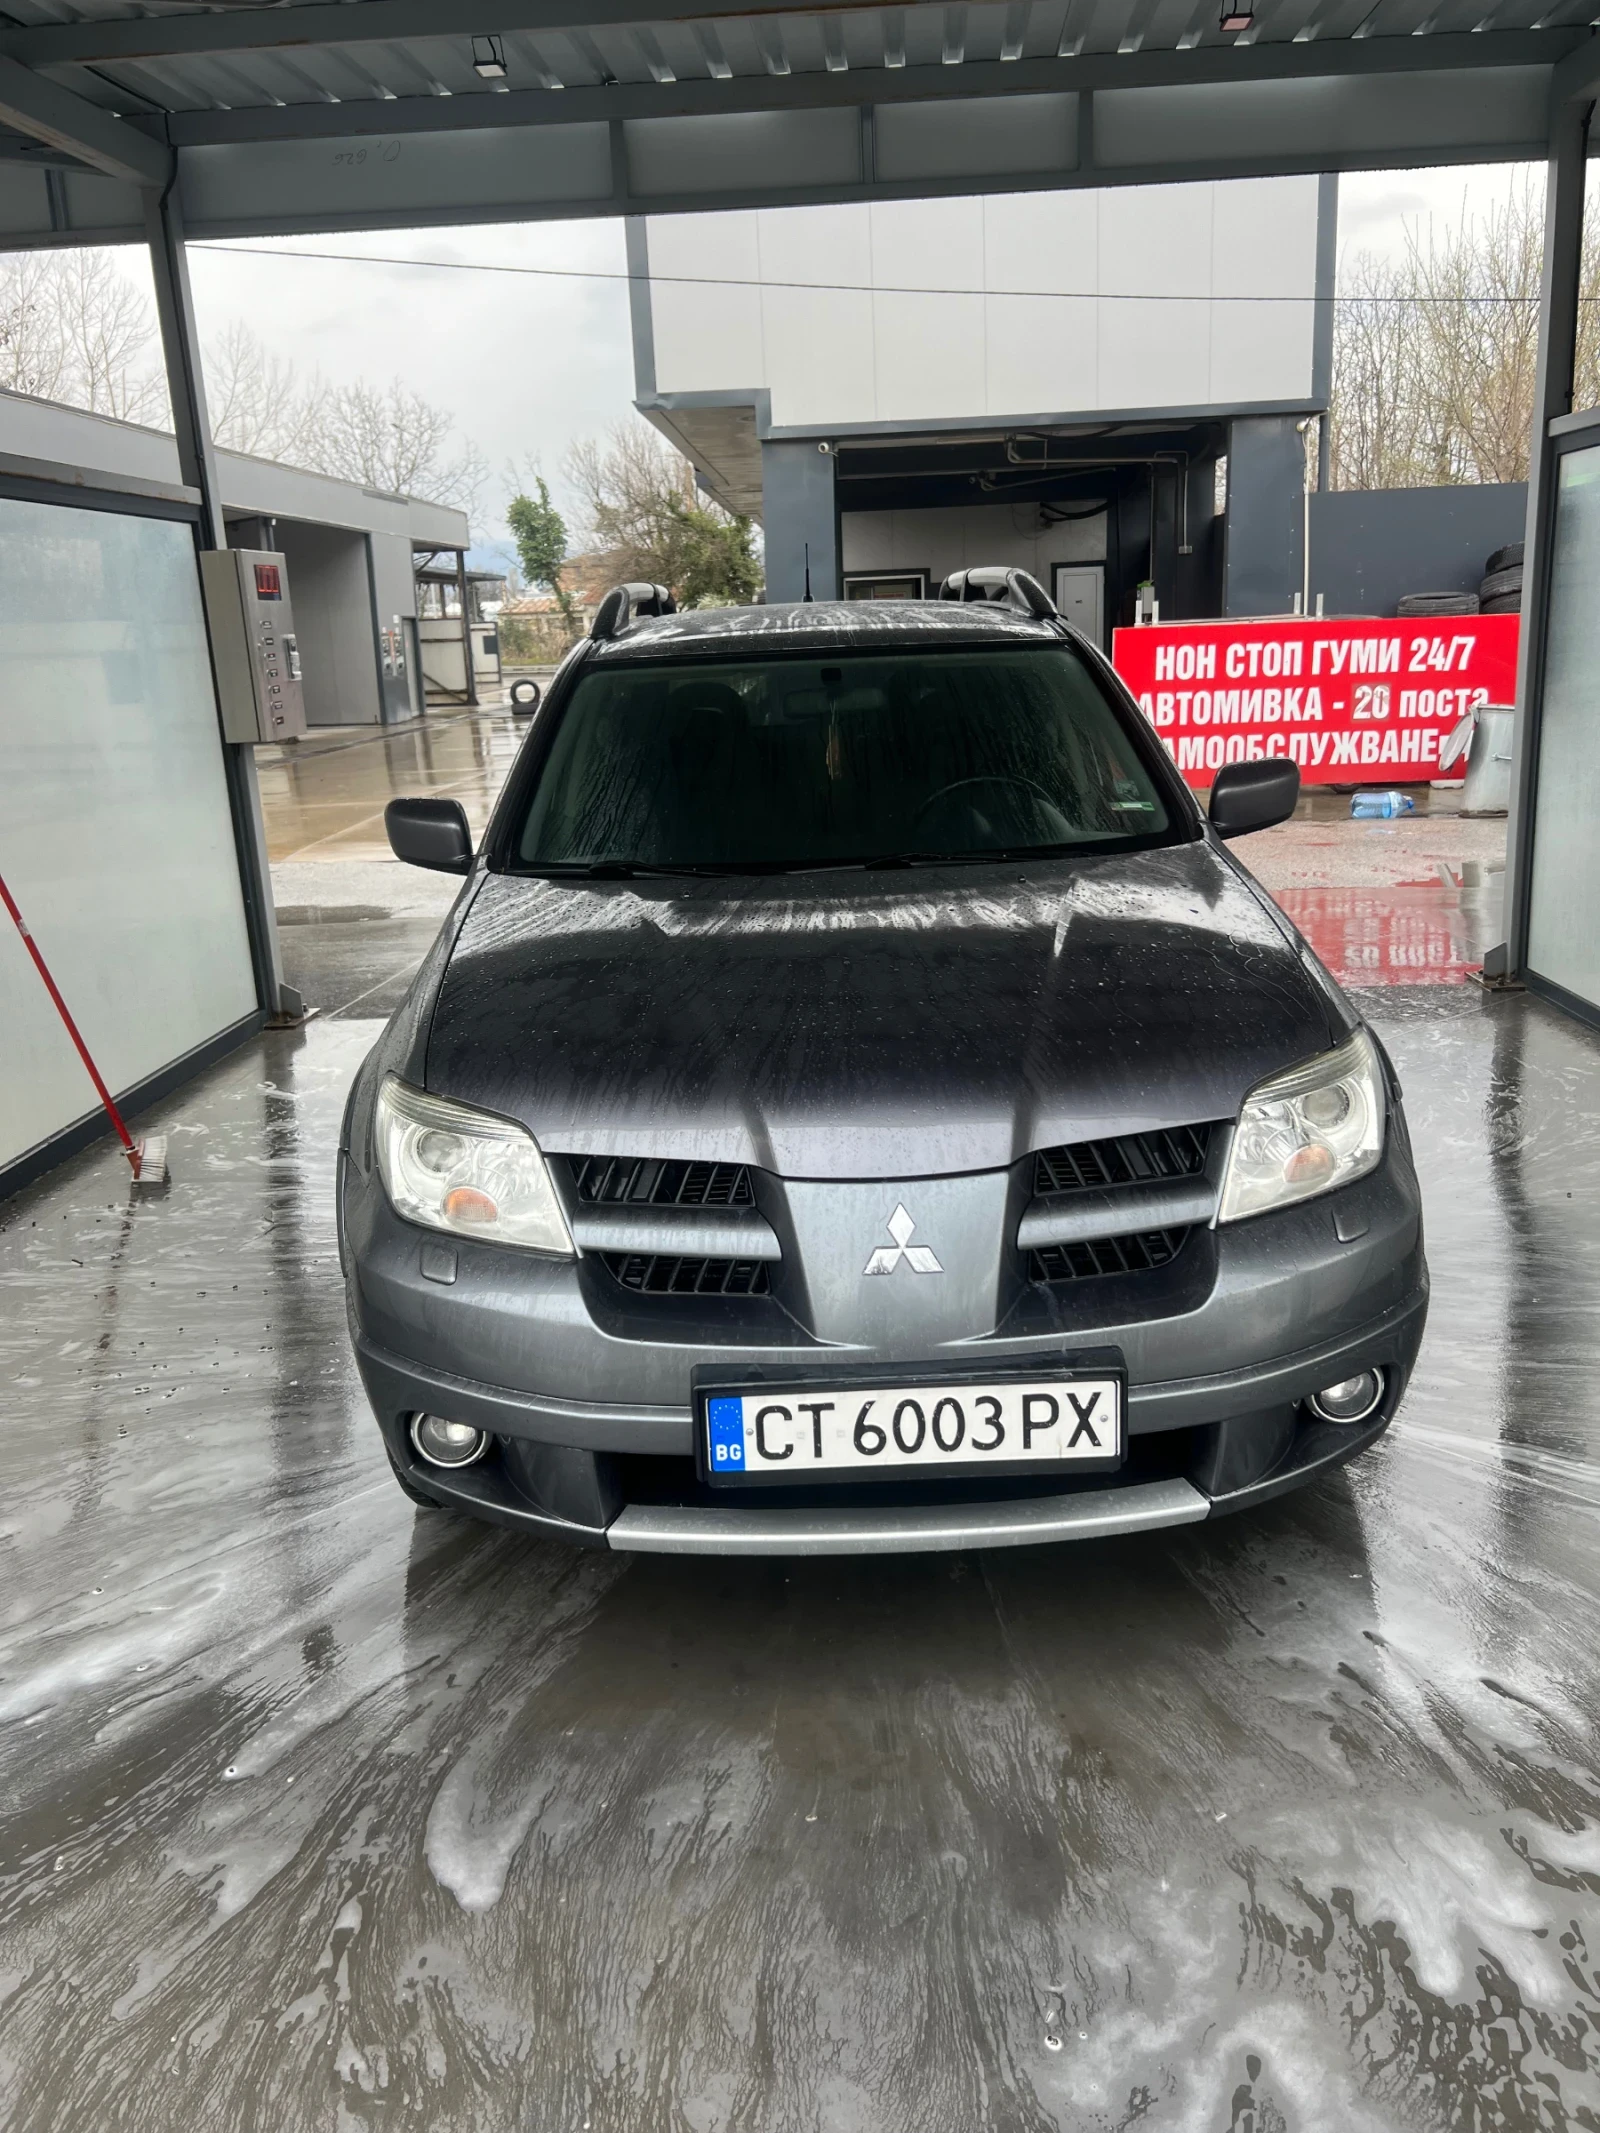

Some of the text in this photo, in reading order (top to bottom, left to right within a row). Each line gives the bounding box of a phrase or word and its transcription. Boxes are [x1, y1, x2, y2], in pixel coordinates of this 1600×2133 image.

[1156, 636, 1476, 681] НОН СТОП ГУМИ 24/7
[1140, 686, 1322, 727] АВТОМИВКА
[1353, 685, 1390, 719] 20
[1163, 728, 1438, 771] МООБСЛУЖВАНЕ
[755, 1391, 1102, 1460] CT 6003 PX
[716, 1444, 741, 1461] BG
